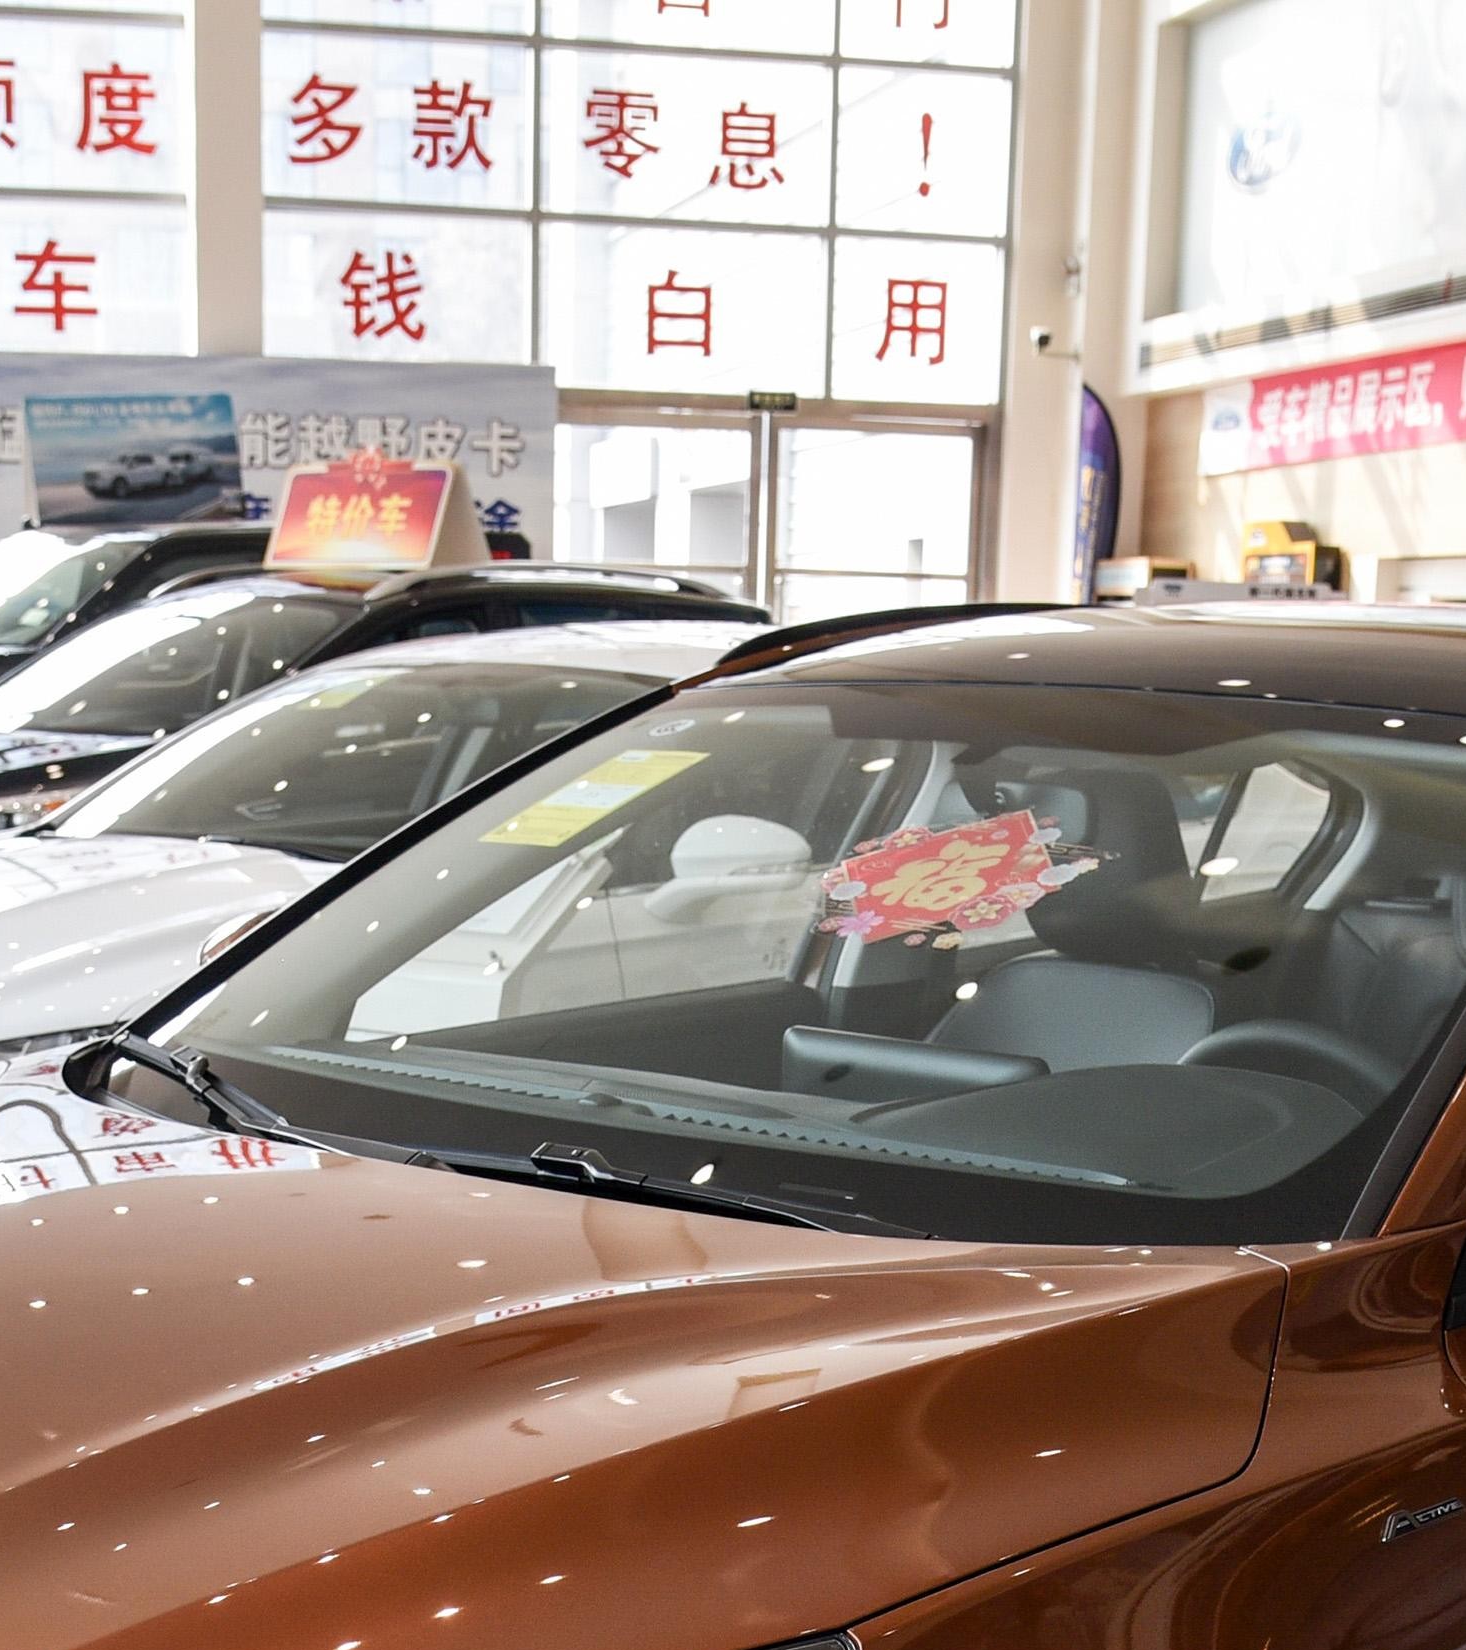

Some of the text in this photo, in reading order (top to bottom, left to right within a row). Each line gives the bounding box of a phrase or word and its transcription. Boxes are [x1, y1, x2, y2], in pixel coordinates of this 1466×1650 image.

[306, 492, 413, 540] 特价车
[871, 838, 1011, 911] 福
